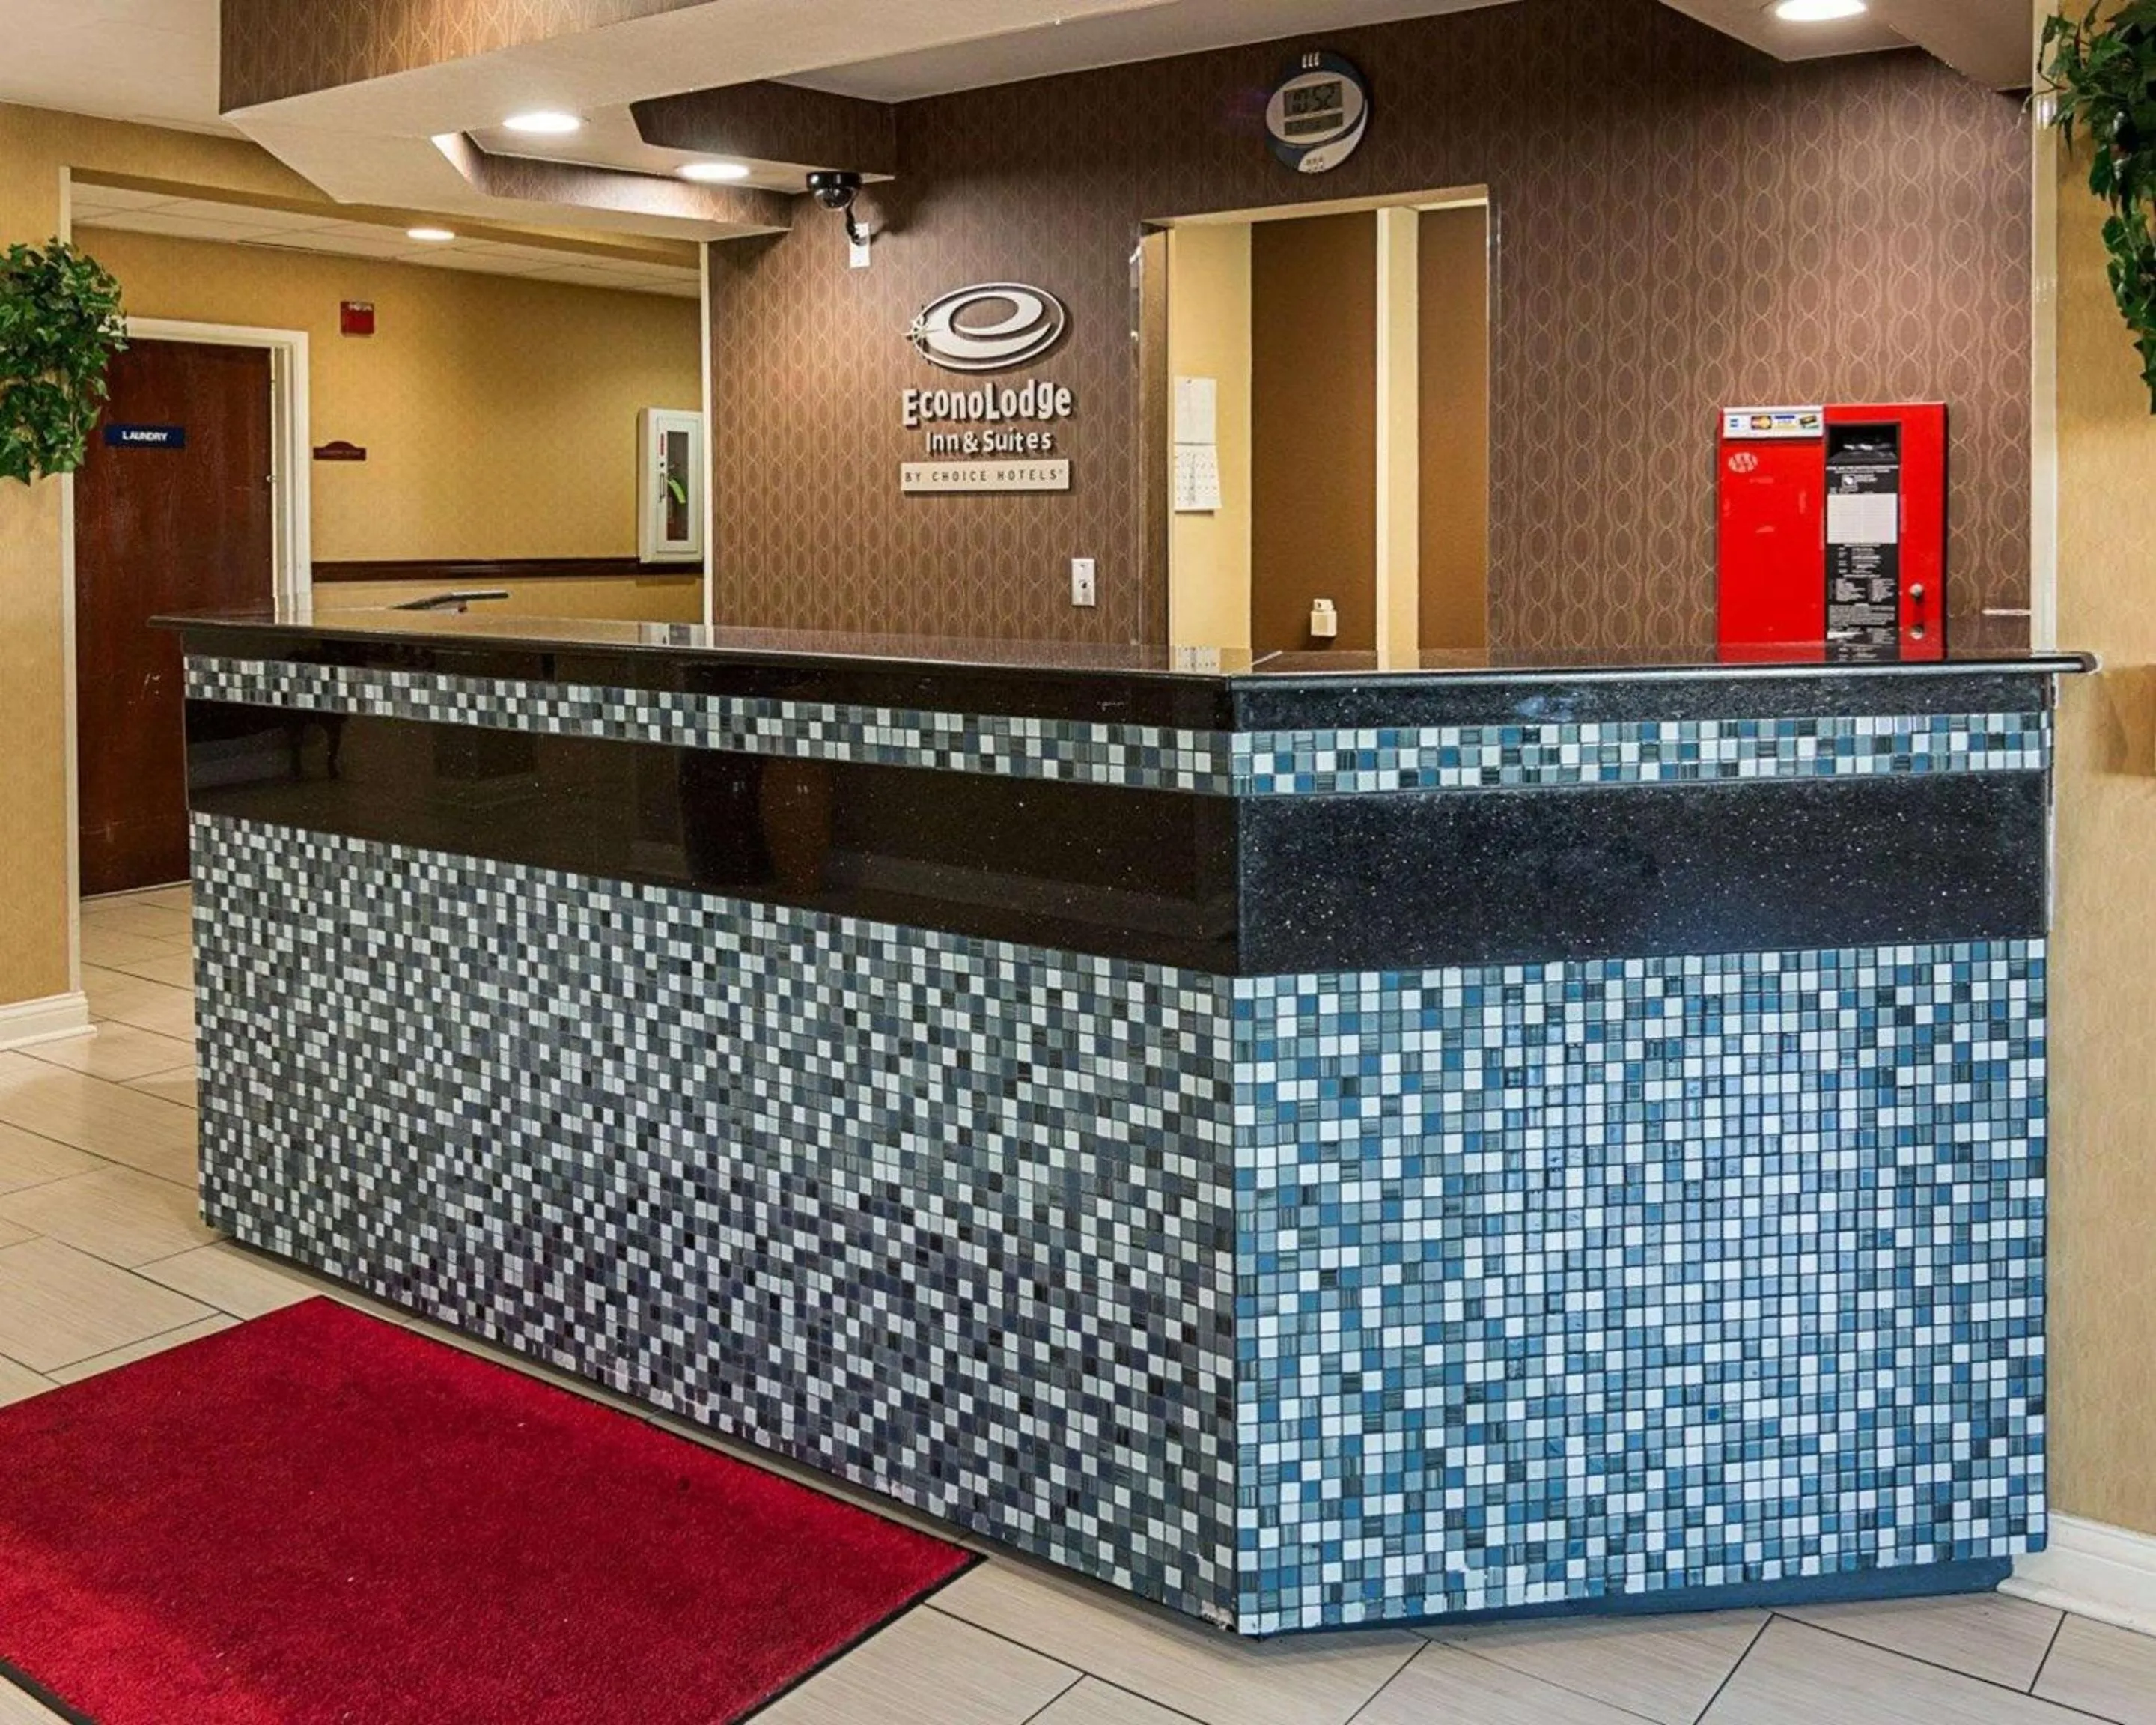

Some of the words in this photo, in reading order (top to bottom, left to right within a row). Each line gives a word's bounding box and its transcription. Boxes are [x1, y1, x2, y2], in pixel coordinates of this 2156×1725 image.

[903, 380, 1071, 425] EconoLodge
[123, 431, 168, 442] LAUNDRY
[905, 472, 921, 482] BY
[932, 470, 987, 481] CHOICE
[997, 469, 1057, 481] HOTELS
